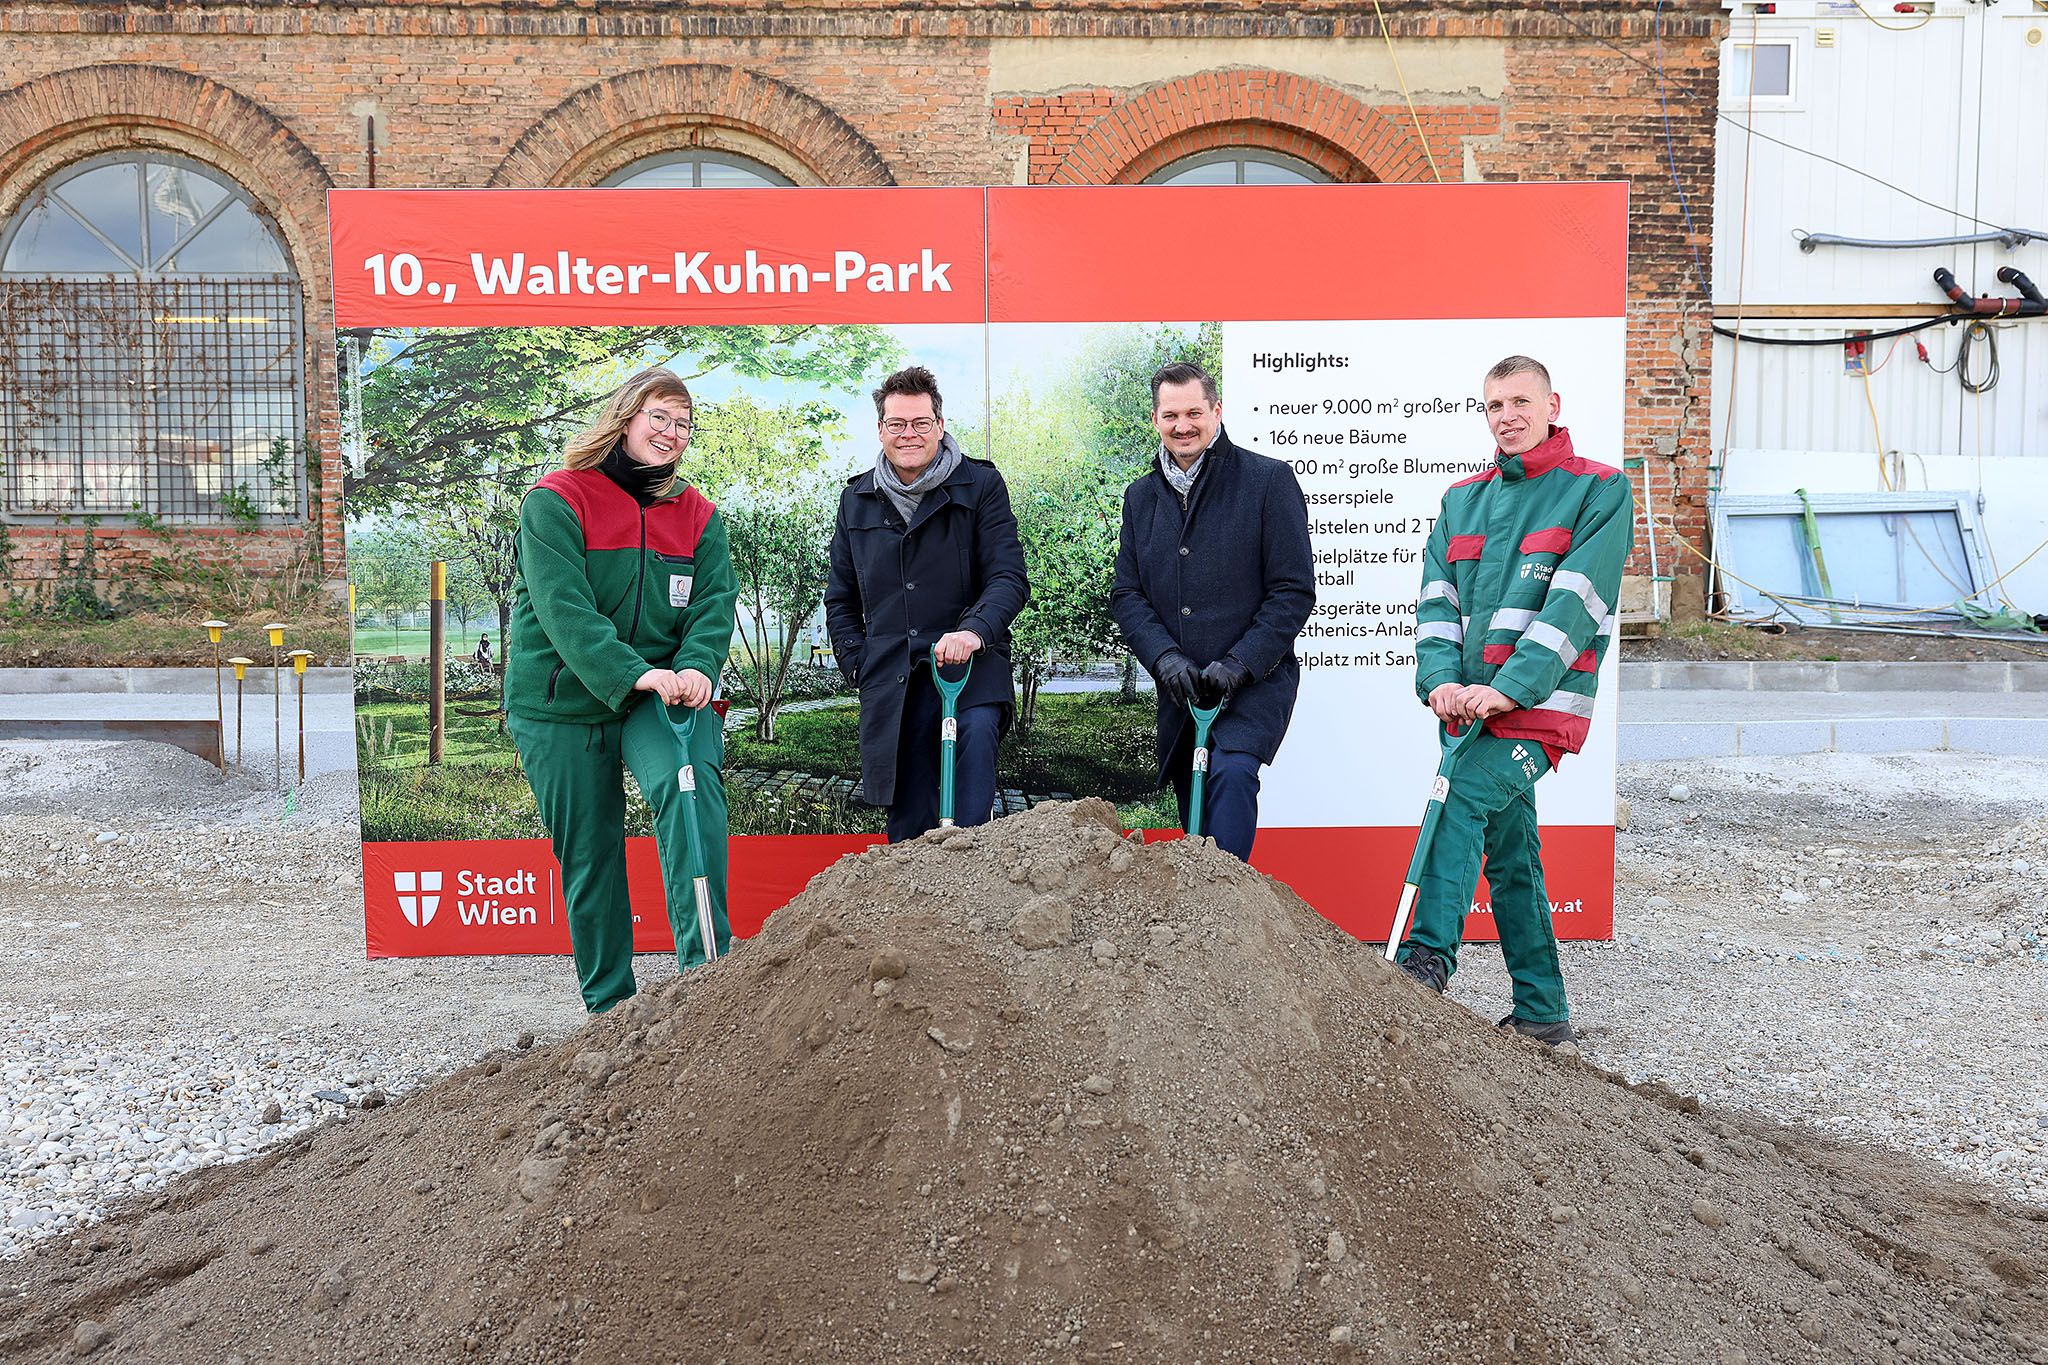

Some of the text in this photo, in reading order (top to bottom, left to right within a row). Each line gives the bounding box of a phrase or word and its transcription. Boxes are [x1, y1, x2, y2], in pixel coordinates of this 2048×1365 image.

[363, 247, 953, 303] 10., Walter-Kuhn-Park
[1253, 352, 1349, 373] Highlights:
[1269, 403, 1318, 415] neuer
[1322, 398, 1372, 415] 9.000
[1403, 397, 1461, 418] großer
[1466, 397, 1486, 413] Pa
[1269, 429, 1407, 445] 166 neue Bäume
[1348, 457, 1399, 479] große
[1404, 457, 1496, 474] Blumenwie
[1303, 488, 1394, 509] asserspiele
[1307, 518, 1369, 534] elstelen
[1374, 517, 1406, 534] und
[1411, 518, 1421, 533] 2
[1392, 547, 1417, 563] für
[1310, 599, 1418, 620] ssgeräte und
[1299, 620, 1418, 640] sthenics-Anla
[1297, 650, 1416, 671] elplatz mit San
[456, 869, 537, 896] Stadt
[456, 900, 537, 926] Wien
